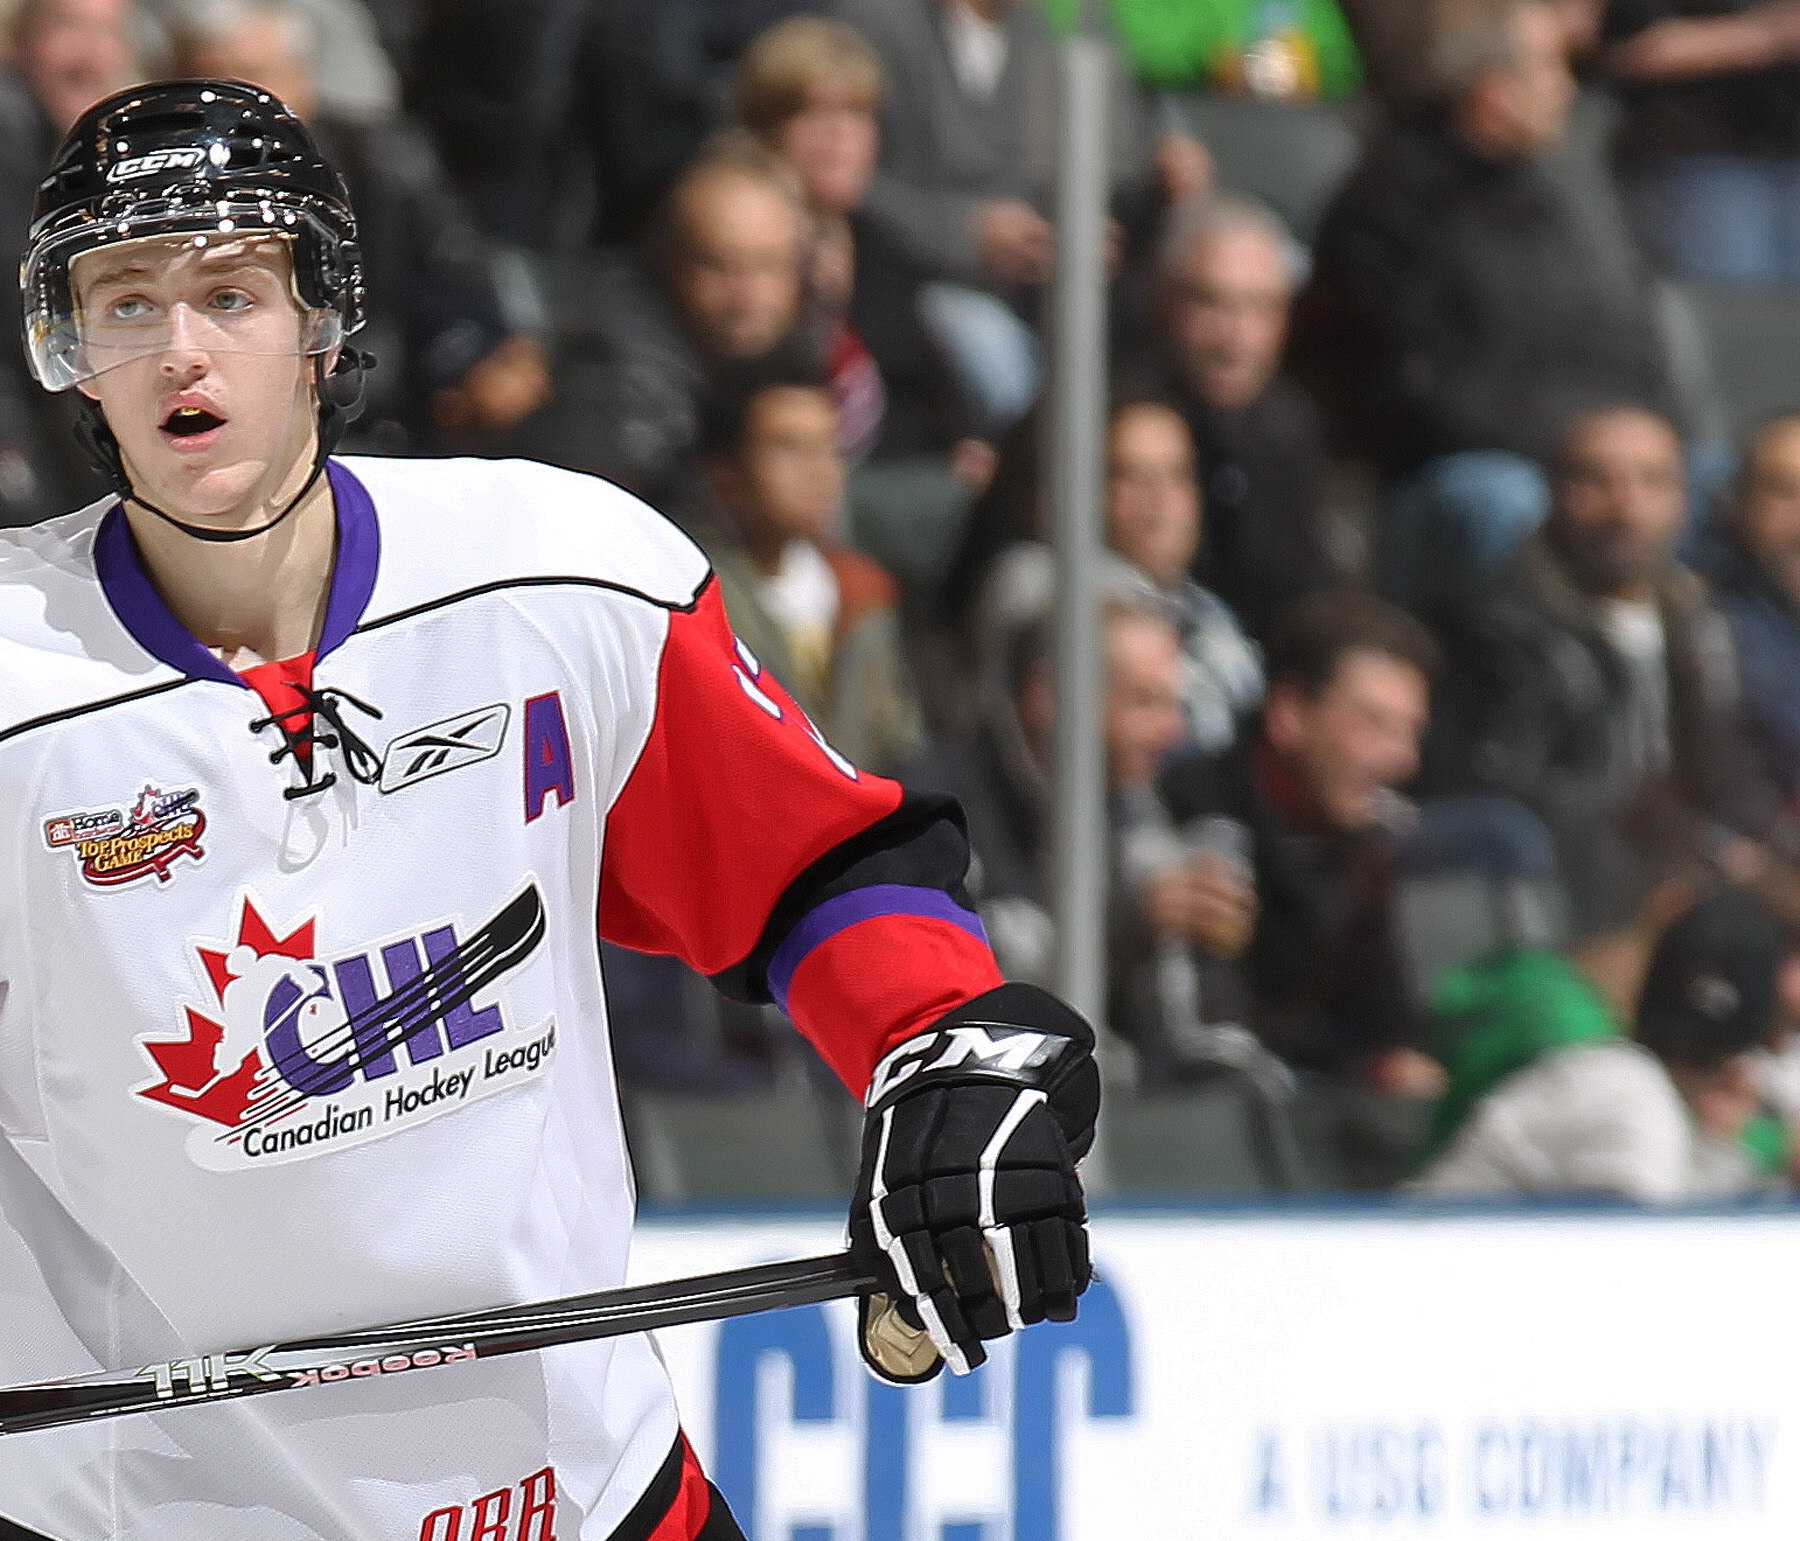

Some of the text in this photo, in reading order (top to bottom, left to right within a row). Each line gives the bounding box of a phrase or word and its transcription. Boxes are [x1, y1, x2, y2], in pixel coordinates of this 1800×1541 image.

[113, 153, 198, 177] CCM
[524, 690, 574, 824] A
[264, 923, 504, 1096] CHL
[243, 1024, 556, 1157] Canadian Hockey Leagu
